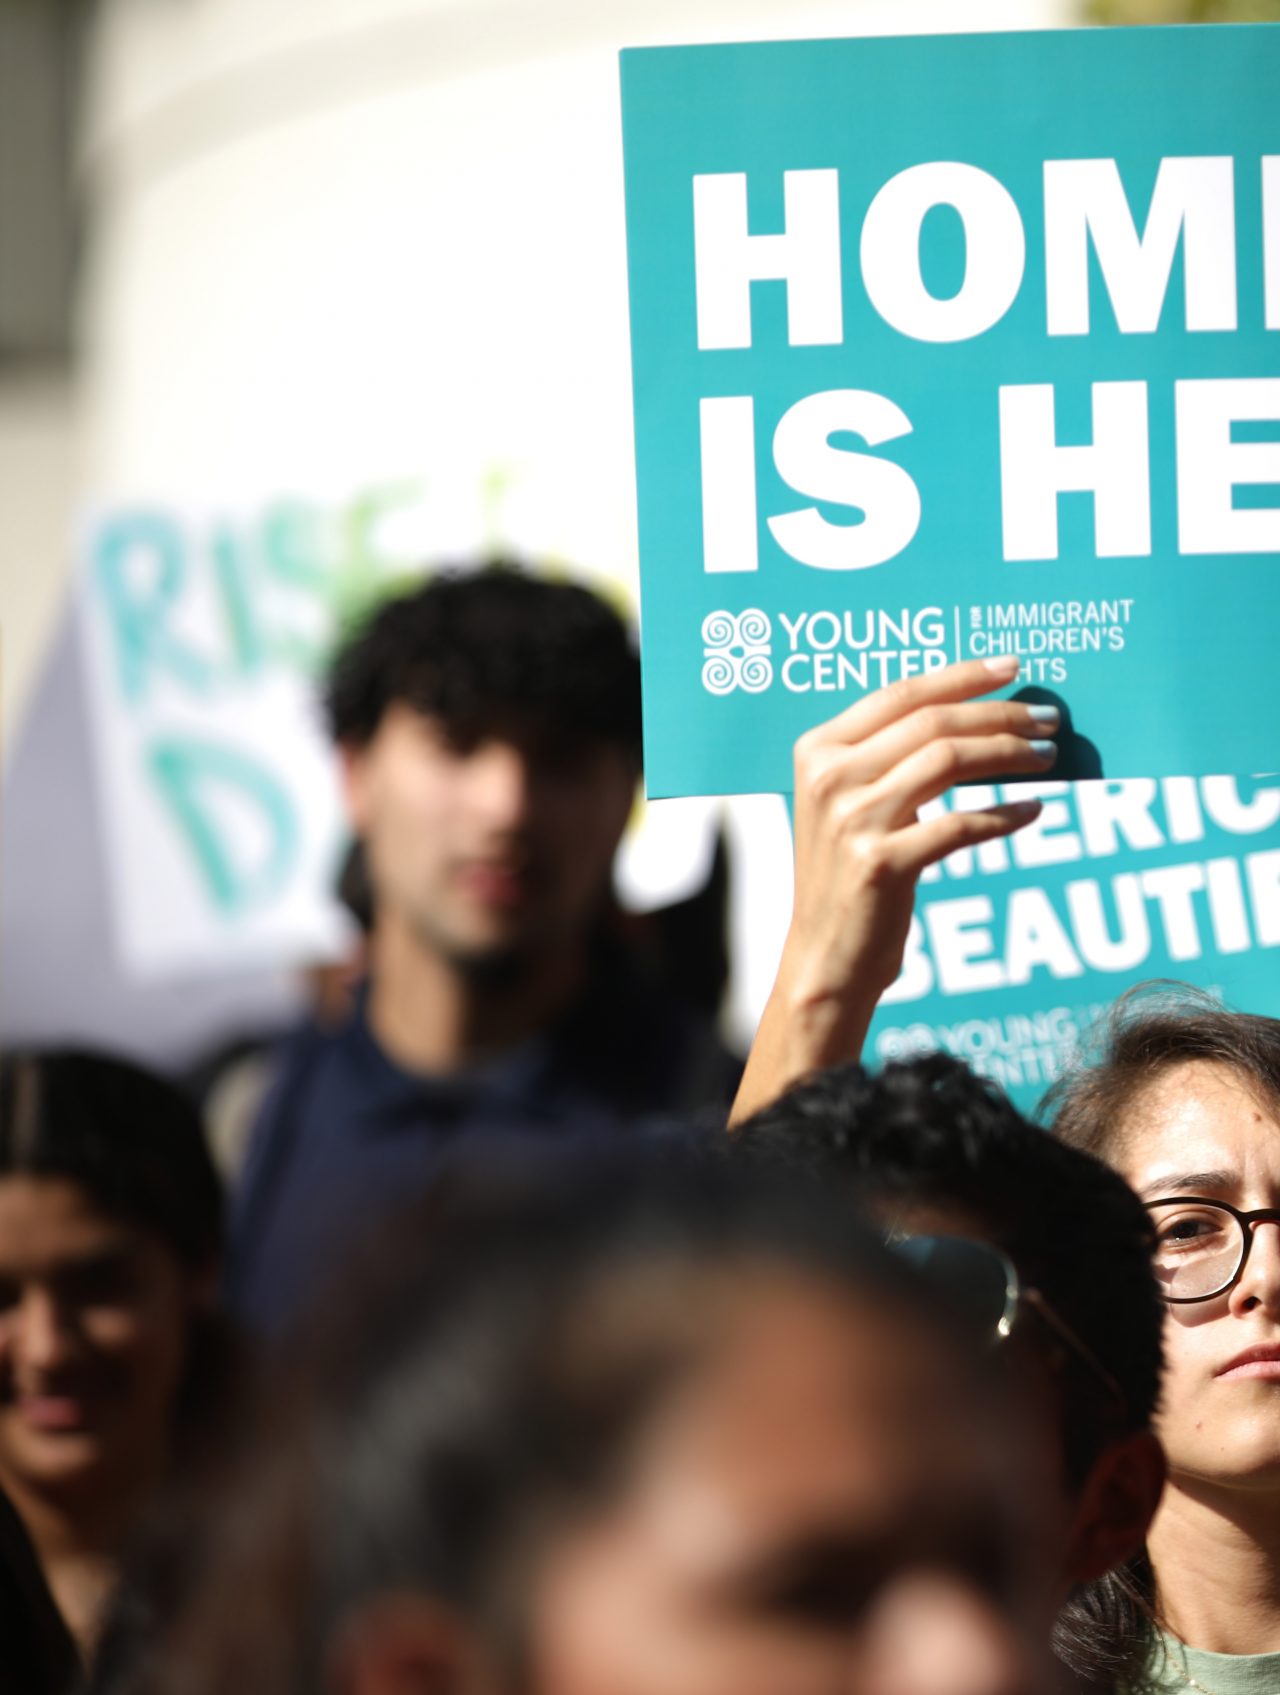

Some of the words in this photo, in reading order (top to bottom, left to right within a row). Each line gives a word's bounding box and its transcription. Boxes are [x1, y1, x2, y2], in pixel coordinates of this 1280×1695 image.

[699, 388, 922, 574] IS
[778, 606, 946, 652] YOUNG
[986, 598, 1134, 630] IMMIGRANT
[968, 625, 1126, 656] CHILDREN'S
[939, 1007, 1080, 1060] YOUNG
